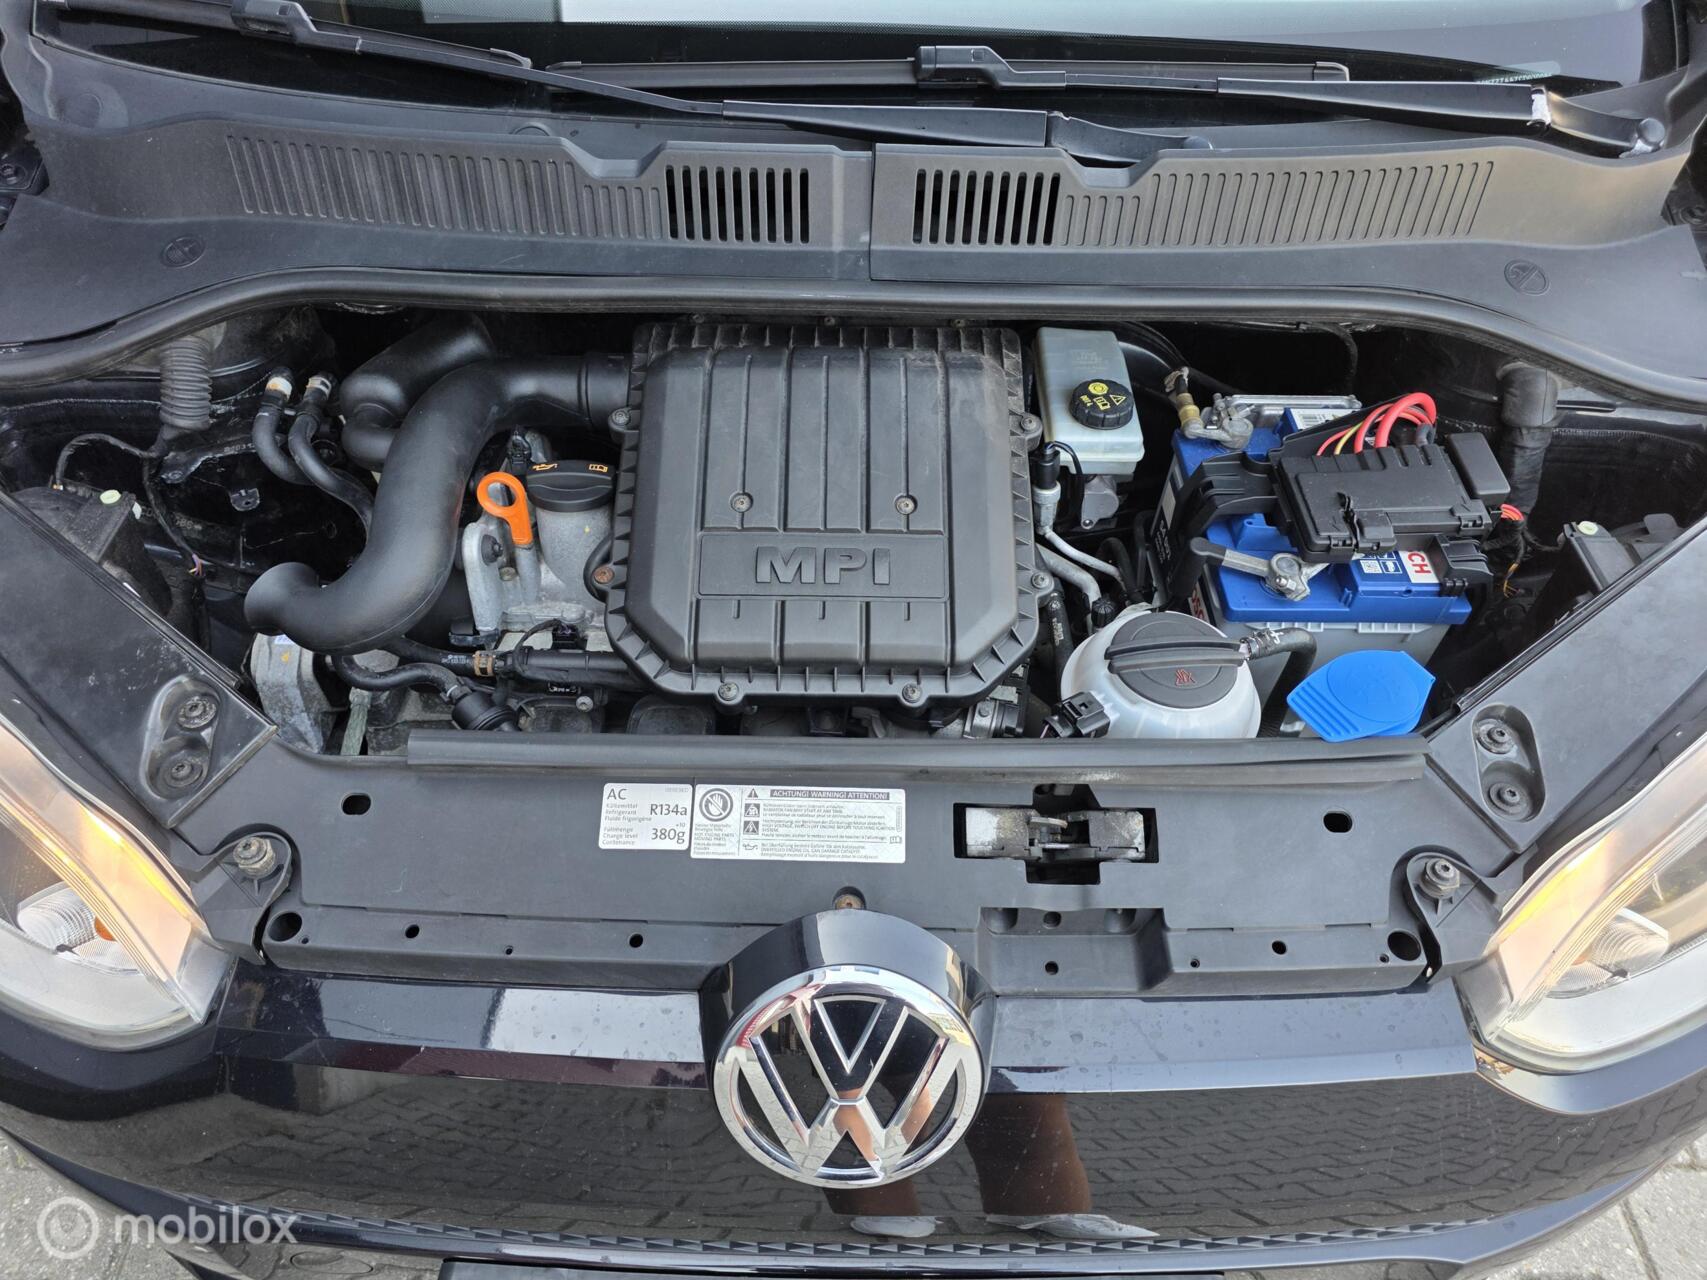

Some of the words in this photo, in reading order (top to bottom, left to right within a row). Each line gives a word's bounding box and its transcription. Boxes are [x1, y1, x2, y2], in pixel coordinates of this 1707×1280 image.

[755, 546, 891, 585] MPI
[1407, 552, 1432, 574] CH
[606, 788, 628, 800] AC
[650, 803, 688, 816] R134a
[651, 828, 686, 845] 380g
